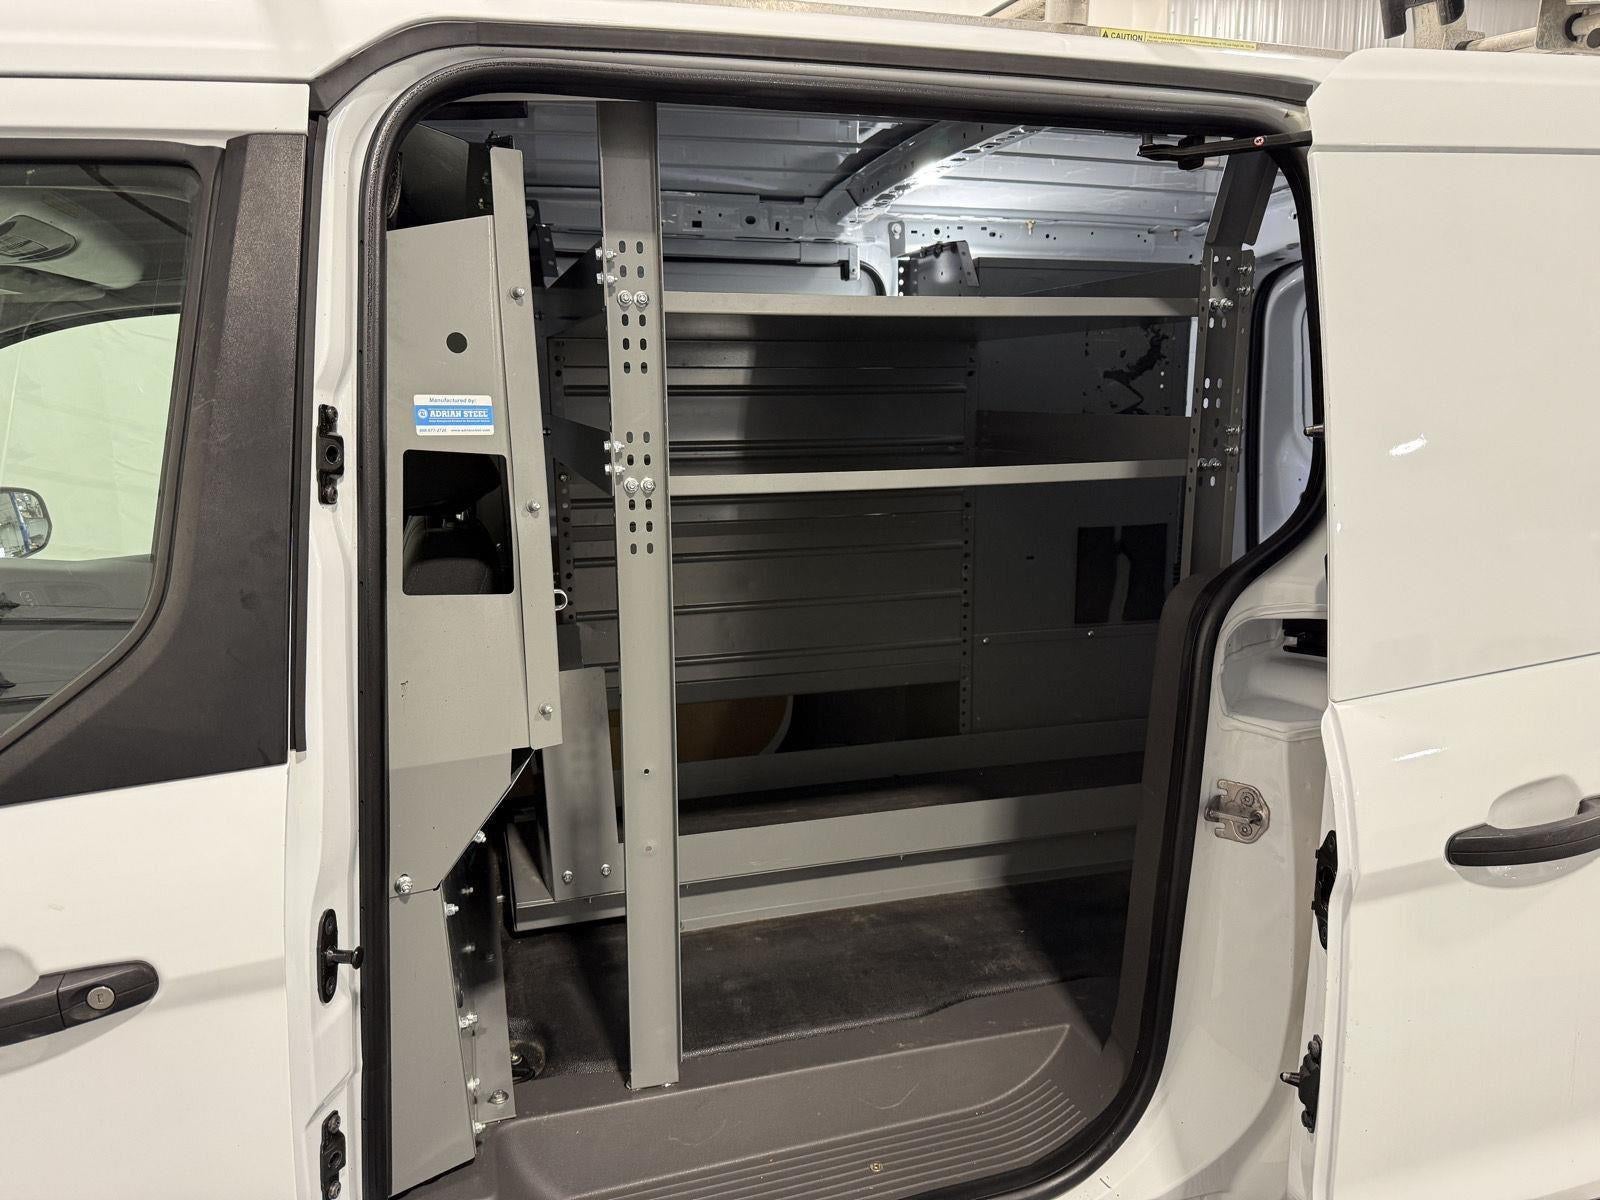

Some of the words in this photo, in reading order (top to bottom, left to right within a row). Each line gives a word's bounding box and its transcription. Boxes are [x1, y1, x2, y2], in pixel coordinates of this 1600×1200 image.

[1110, 32, 1143, 41] CAUTION
[430, 410, 462, 418] ADRIAN
[463, 410, 488, 418] STEEL
